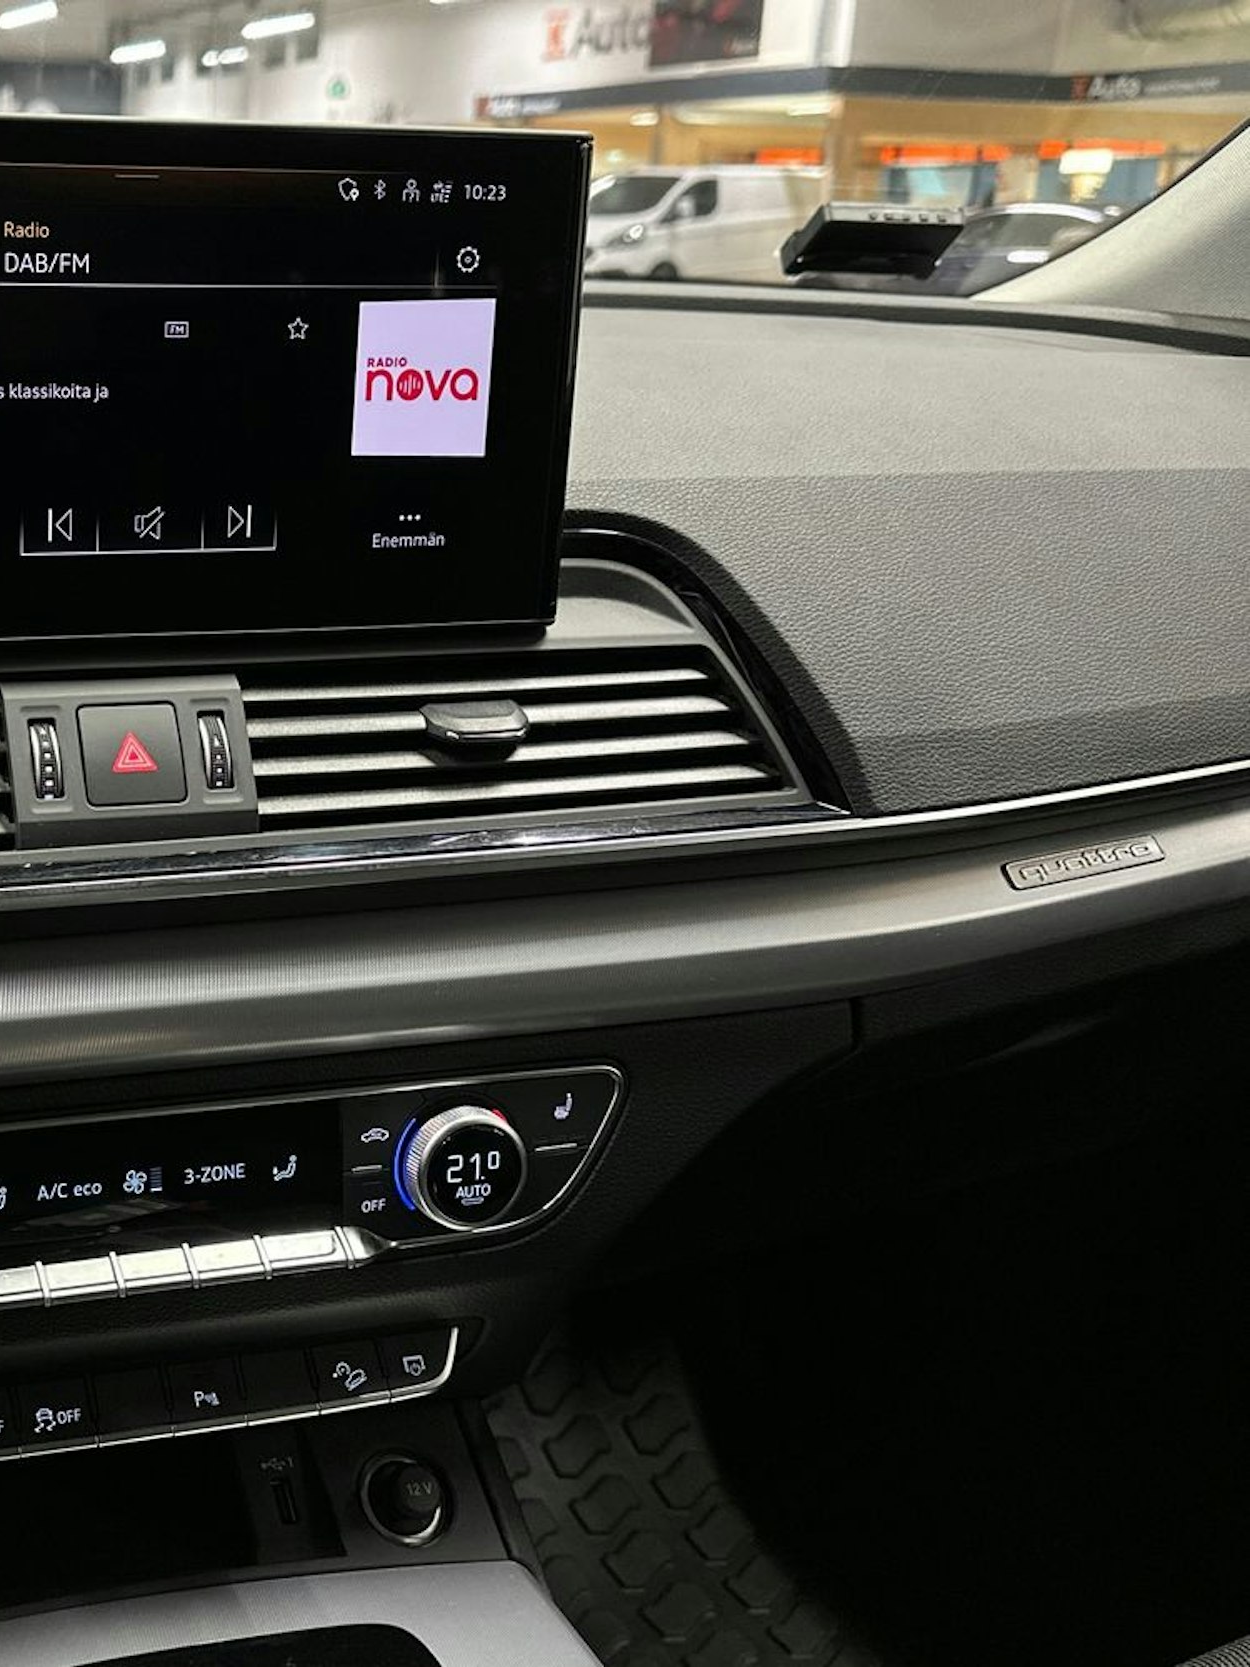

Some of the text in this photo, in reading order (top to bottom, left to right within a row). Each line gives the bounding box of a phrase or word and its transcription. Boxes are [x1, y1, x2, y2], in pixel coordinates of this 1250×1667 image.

[464, 184, 507, 202] 10:23
[3, 221, 51, 239] Radio
[3, 252, 91, 275] DAB/FM
[367, 357, 408, 368] RADIO
[8, 382, 91, 401] klassikoita
[93, 383, 110, 405] ja
[365, 368, 480, 402] nova
[371, 532, 446, 549] Enemmän
[1018, 843, 1151, 882] quattro
[183, 1162, 247, 1186] 3-ZONE
[36, 1182, 103, 1202] A/C eco
[455, 1184, 492, 1200] AUTO
[360, 1198, 388, 1214] OFF
[56, 1408, 82, 1425] OFF
